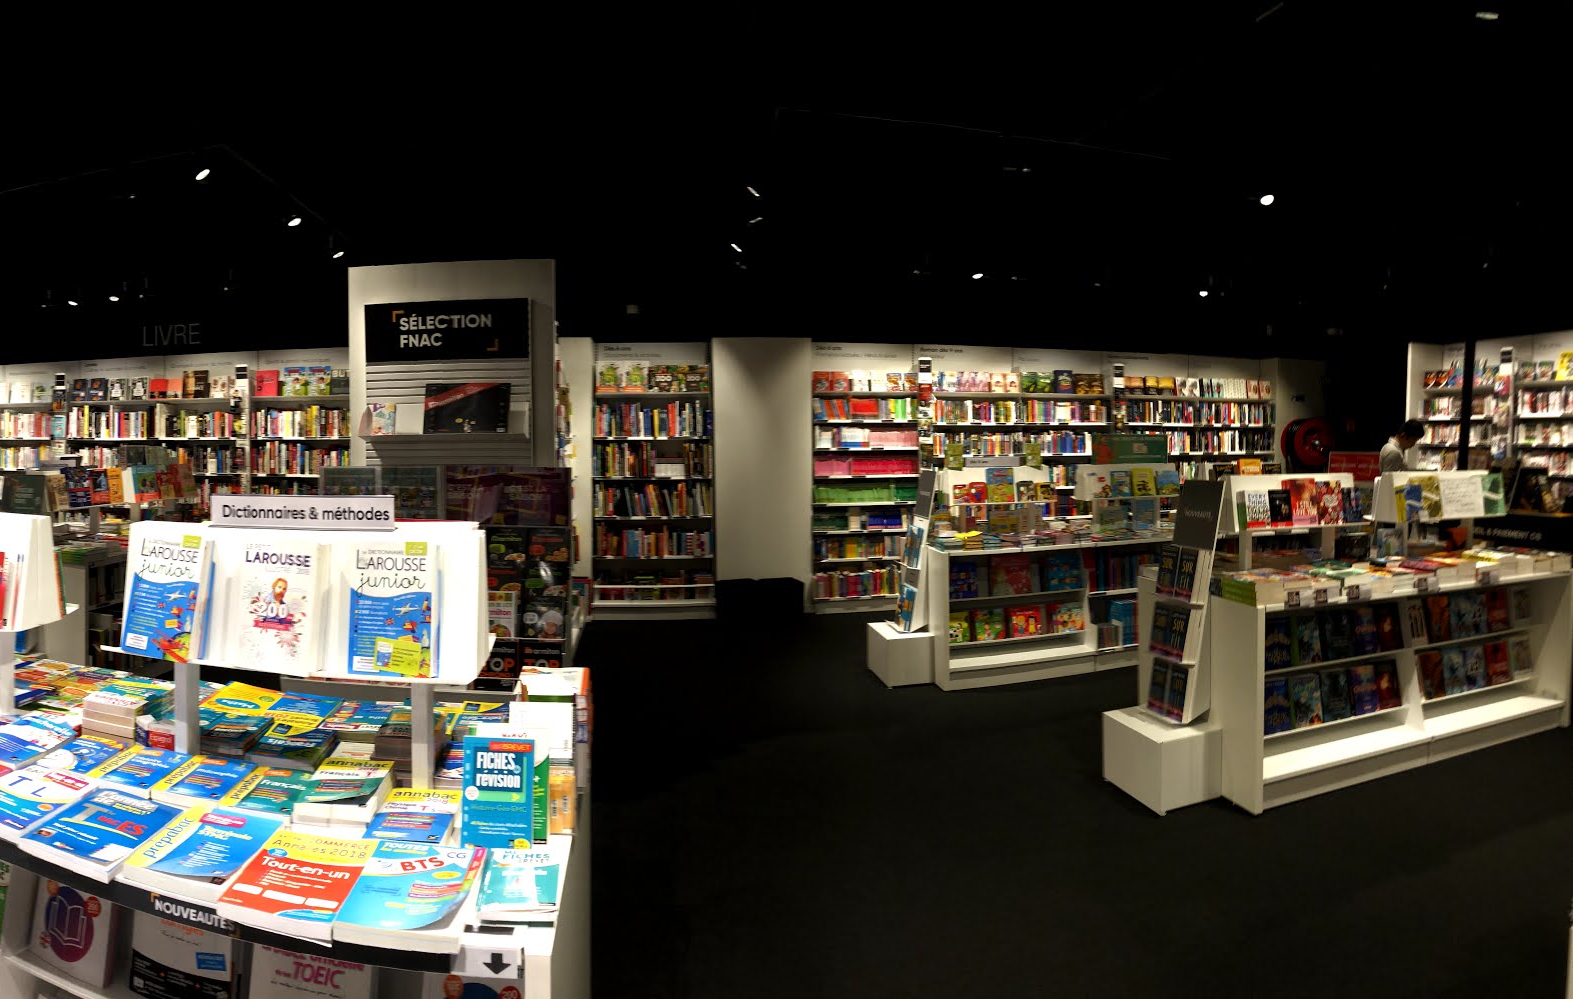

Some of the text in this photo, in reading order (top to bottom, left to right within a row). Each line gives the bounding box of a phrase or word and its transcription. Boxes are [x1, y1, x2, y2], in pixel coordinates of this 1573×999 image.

[399, 313, 493, 332] SÉLECTION
[142, 322, 202, 348] LIVRE
[399, 332, 443, 349] FNAC
[222, 504, 390, 521] Dictionnaires & méthodes
[141, 538, 199, 564] LAROUSSE
[245, 550, 311, 568] LAROUSSE
[356, 548, 427, 572] LAROUSSE
[138, 559, 195, 581] junior
[1182, 560, 1194, 574] SUR
[356, 572, 426, 599] junior
[257, 601, 289, 618] 200
[326, 759, 389, 768] annabac
[477, 751, 517, 771] FICHES
[164, 759, 197, 785] prepabac
[317, 769, 361, 778] Français
[476, 769, 521, 790] révision
[230, 771, 260, 800] prepabac
[260, 778, 307, 792] Français
[392, 789, 459, 801] annabac
[426, 798, 449, 806] 2018
[117, 820, 147, 836] ES
[143, 816, 197, 860] prepabac
[313, 838, 371, 851] OMMERCE
[272, 839, 367, 859] Annaes 2018
[446, 851, 467, 860] CG
[502, 852, 550, 860] FICHES
[261, 855, 351, 880] Tout-en-un
[400, 857, 445, 873] BTS
[154, 899, 236, 931] NOUVEAUTÉS
[291, 960, 345, 989] TOEIC
